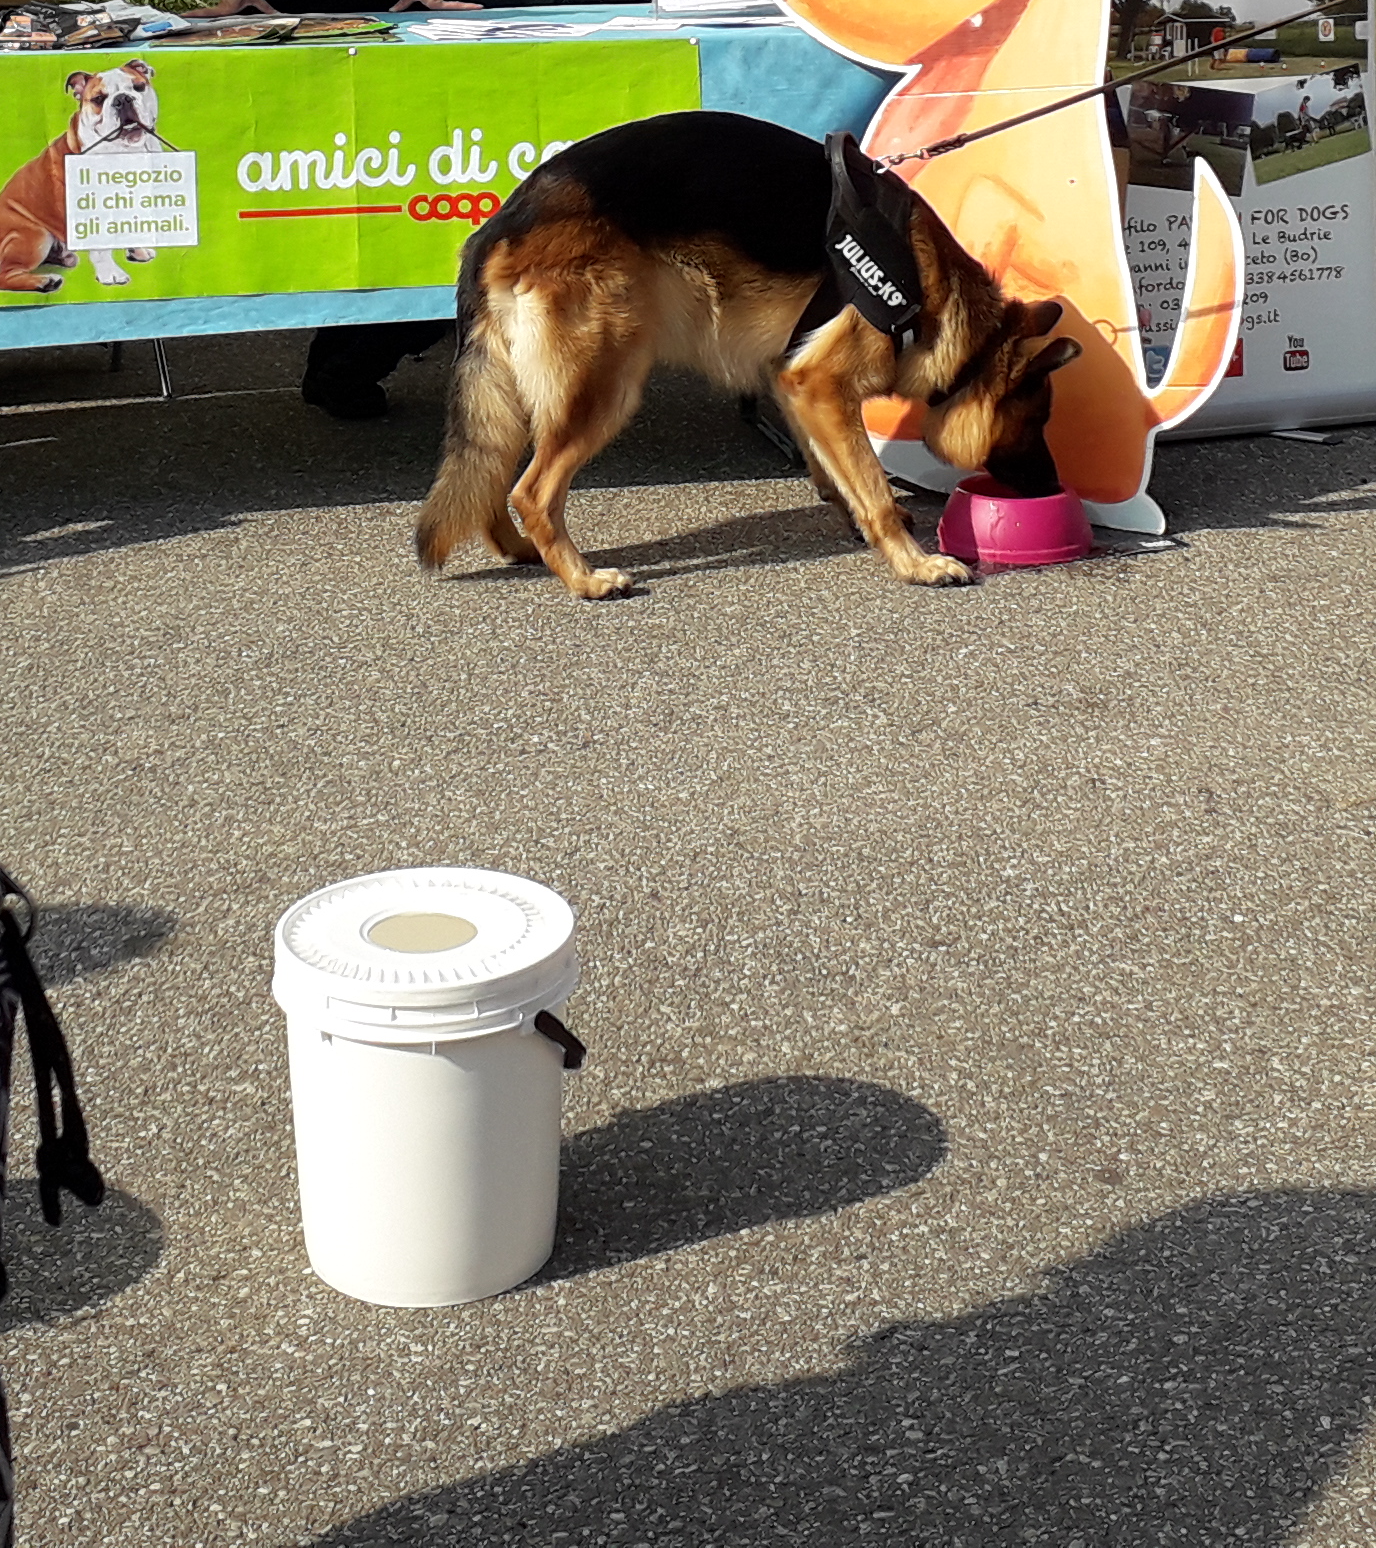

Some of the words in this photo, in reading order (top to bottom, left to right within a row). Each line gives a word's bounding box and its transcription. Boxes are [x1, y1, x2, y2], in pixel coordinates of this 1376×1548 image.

[236, 130, 418, 192] amici
[427, 129, 499, 187] di
[79, 168, 90, 185] Il
[97, 164, 183, 188] negozio
[77, 192, 96, 210] di
[103, 191, 134, 210] chi
[140, 193, 186, 208] ama
[407, 192, 501, 226] coop
[74, 216, 100, 240] gli
[106, 213, 190, 234] animali.
[1124, 216, 1157, 236] filo
[1250, 208, 1289, 225] FOR
[1296, 204, 1349, 223] DOGS
[1138, 238, 1170, 255] 109,
[1252, 232, 1271, 245] Le
[1277, 227, 1332, 244] Budrie
[834, 233, 904, 307] JULIUS-K9
[1132, 258, 1171, 273] anni
[1287, 335, 1305, 349] You
[1284, 353, 1309, 368] Tube
